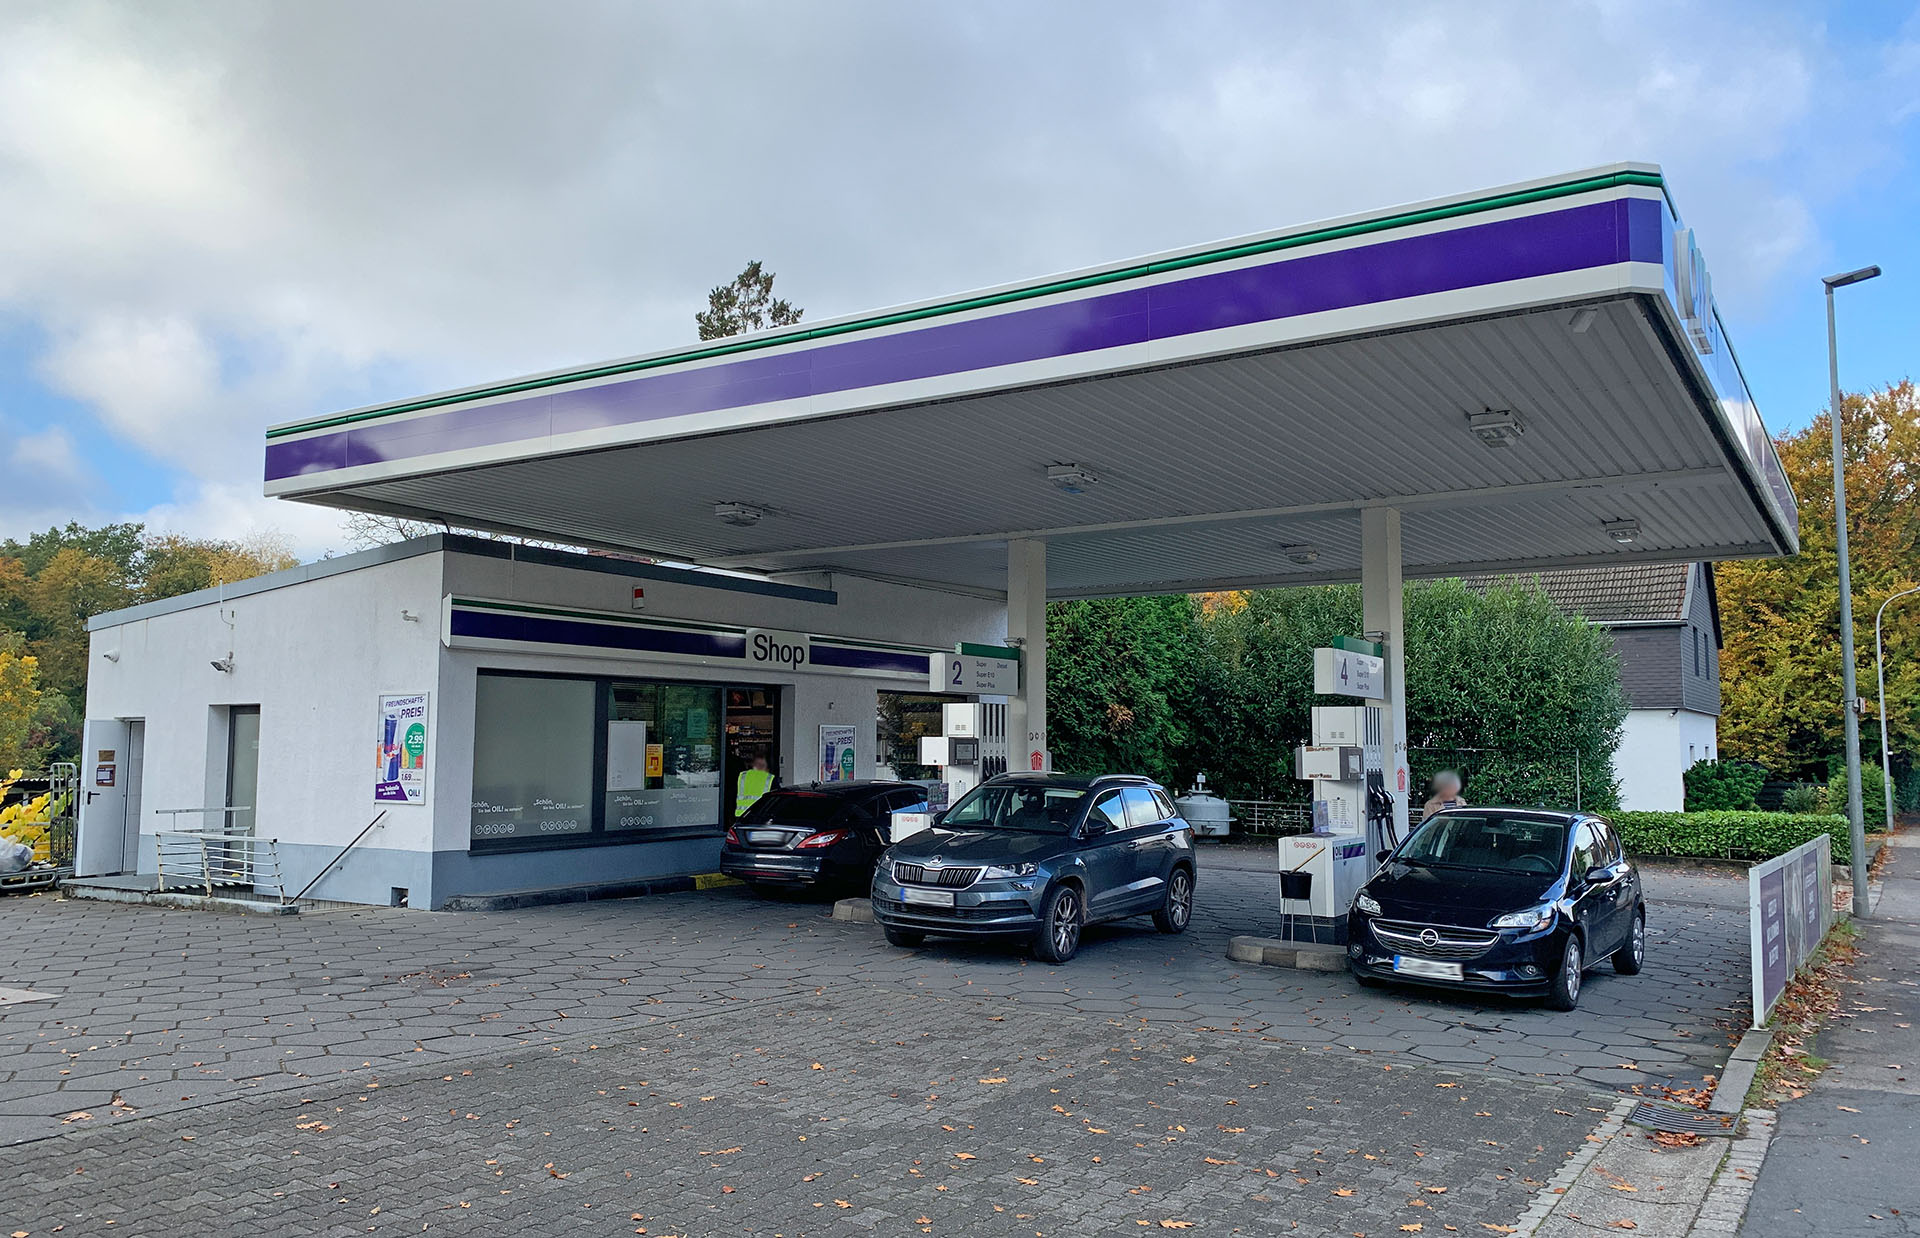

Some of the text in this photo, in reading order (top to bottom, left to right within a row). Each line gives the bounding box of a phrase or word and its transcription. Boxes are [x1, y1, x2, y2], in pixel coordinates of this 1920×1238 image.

[752, 634, 805, 671] Shop
[952, 660, 963, 686] 2
[1341, 657, 1348, 686] 4
[976, 681, 988, 689] Super
[385, 696, 425, 708] FREUNDSCHAFTS-
[400, 706, 425, 719] PREIS!
